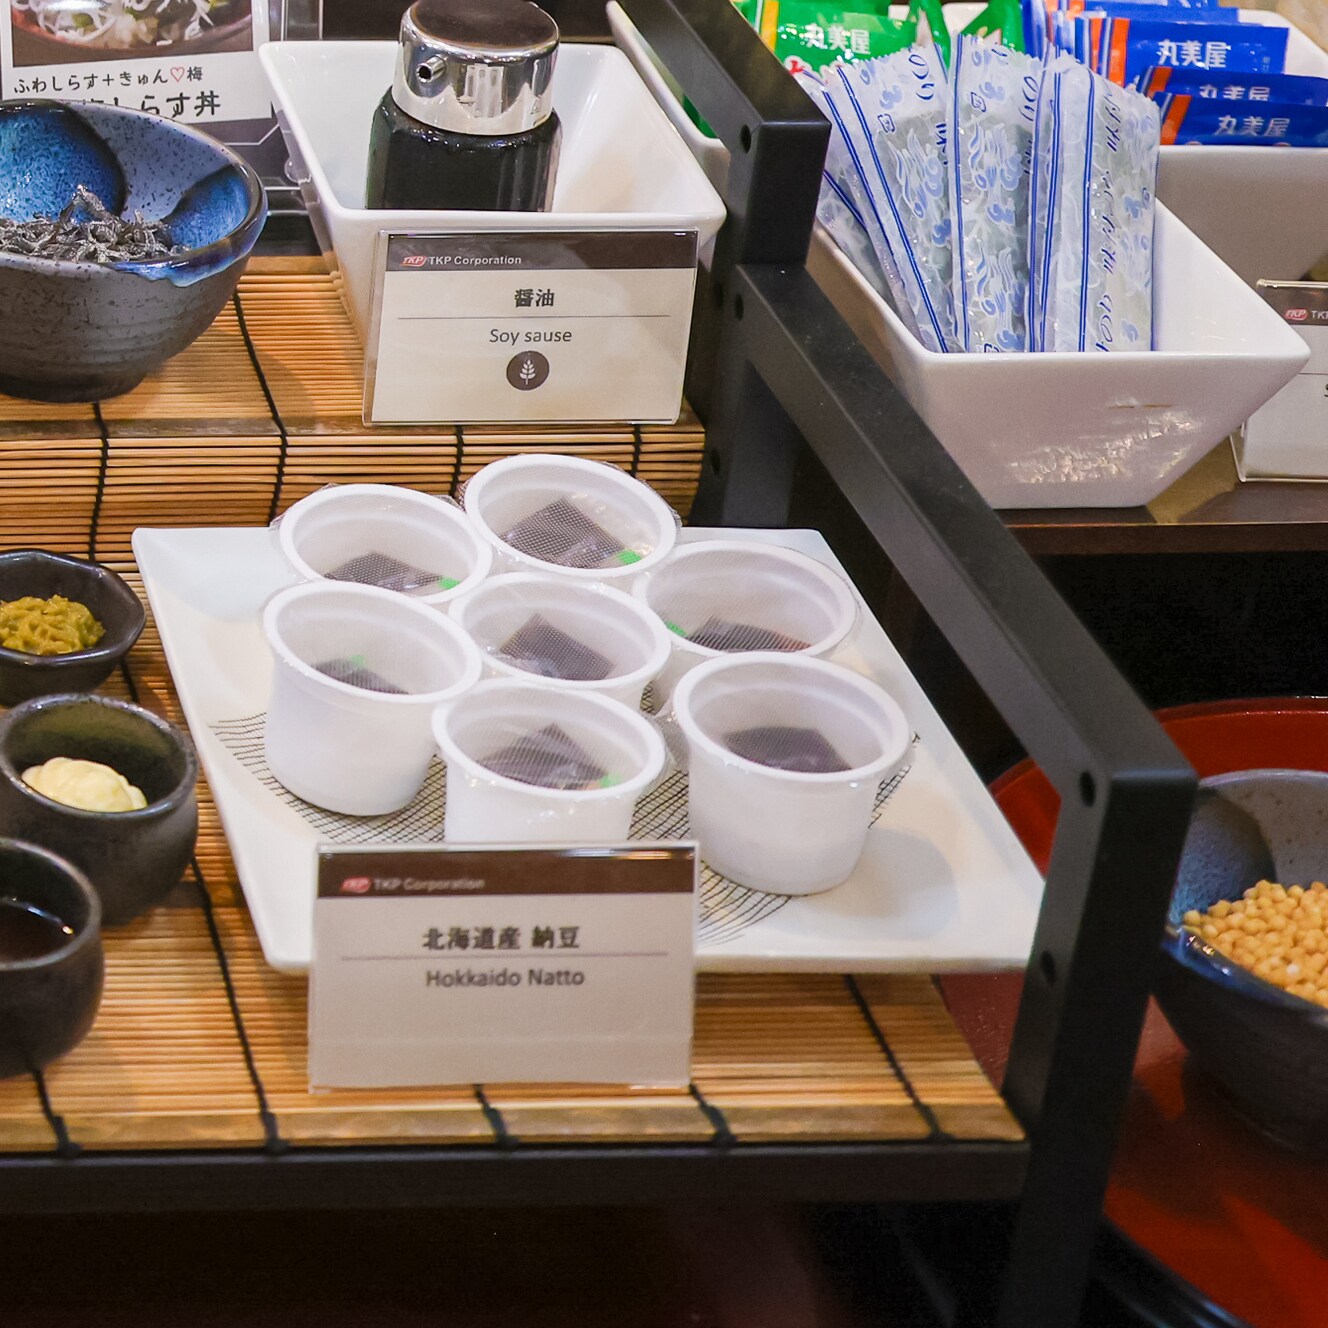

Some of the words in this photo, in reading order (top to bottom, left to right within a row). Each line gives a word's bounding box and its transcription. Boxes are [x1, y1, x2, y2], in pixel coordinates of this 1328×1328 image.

[807, 23, 871, 55] 丸美屋
[1156, 38, 1228, 68] 丸美屋
[1214, 115, 1290, 138] 丸美屋
[429, 256, 452, 265] TKP
[454, 255, 522, 266] Corporation
[515, 289, 554, 307] 醤油
[490, 329, 519, 345] Soy
[525, 332, 572, 342] sause
[422, 927, 521, 950] 北海道産
[532, 926, 580, 949] 納豆
[425, 969, 522, 988] Hokkaido
[527, 969, 586, 987] Natto
